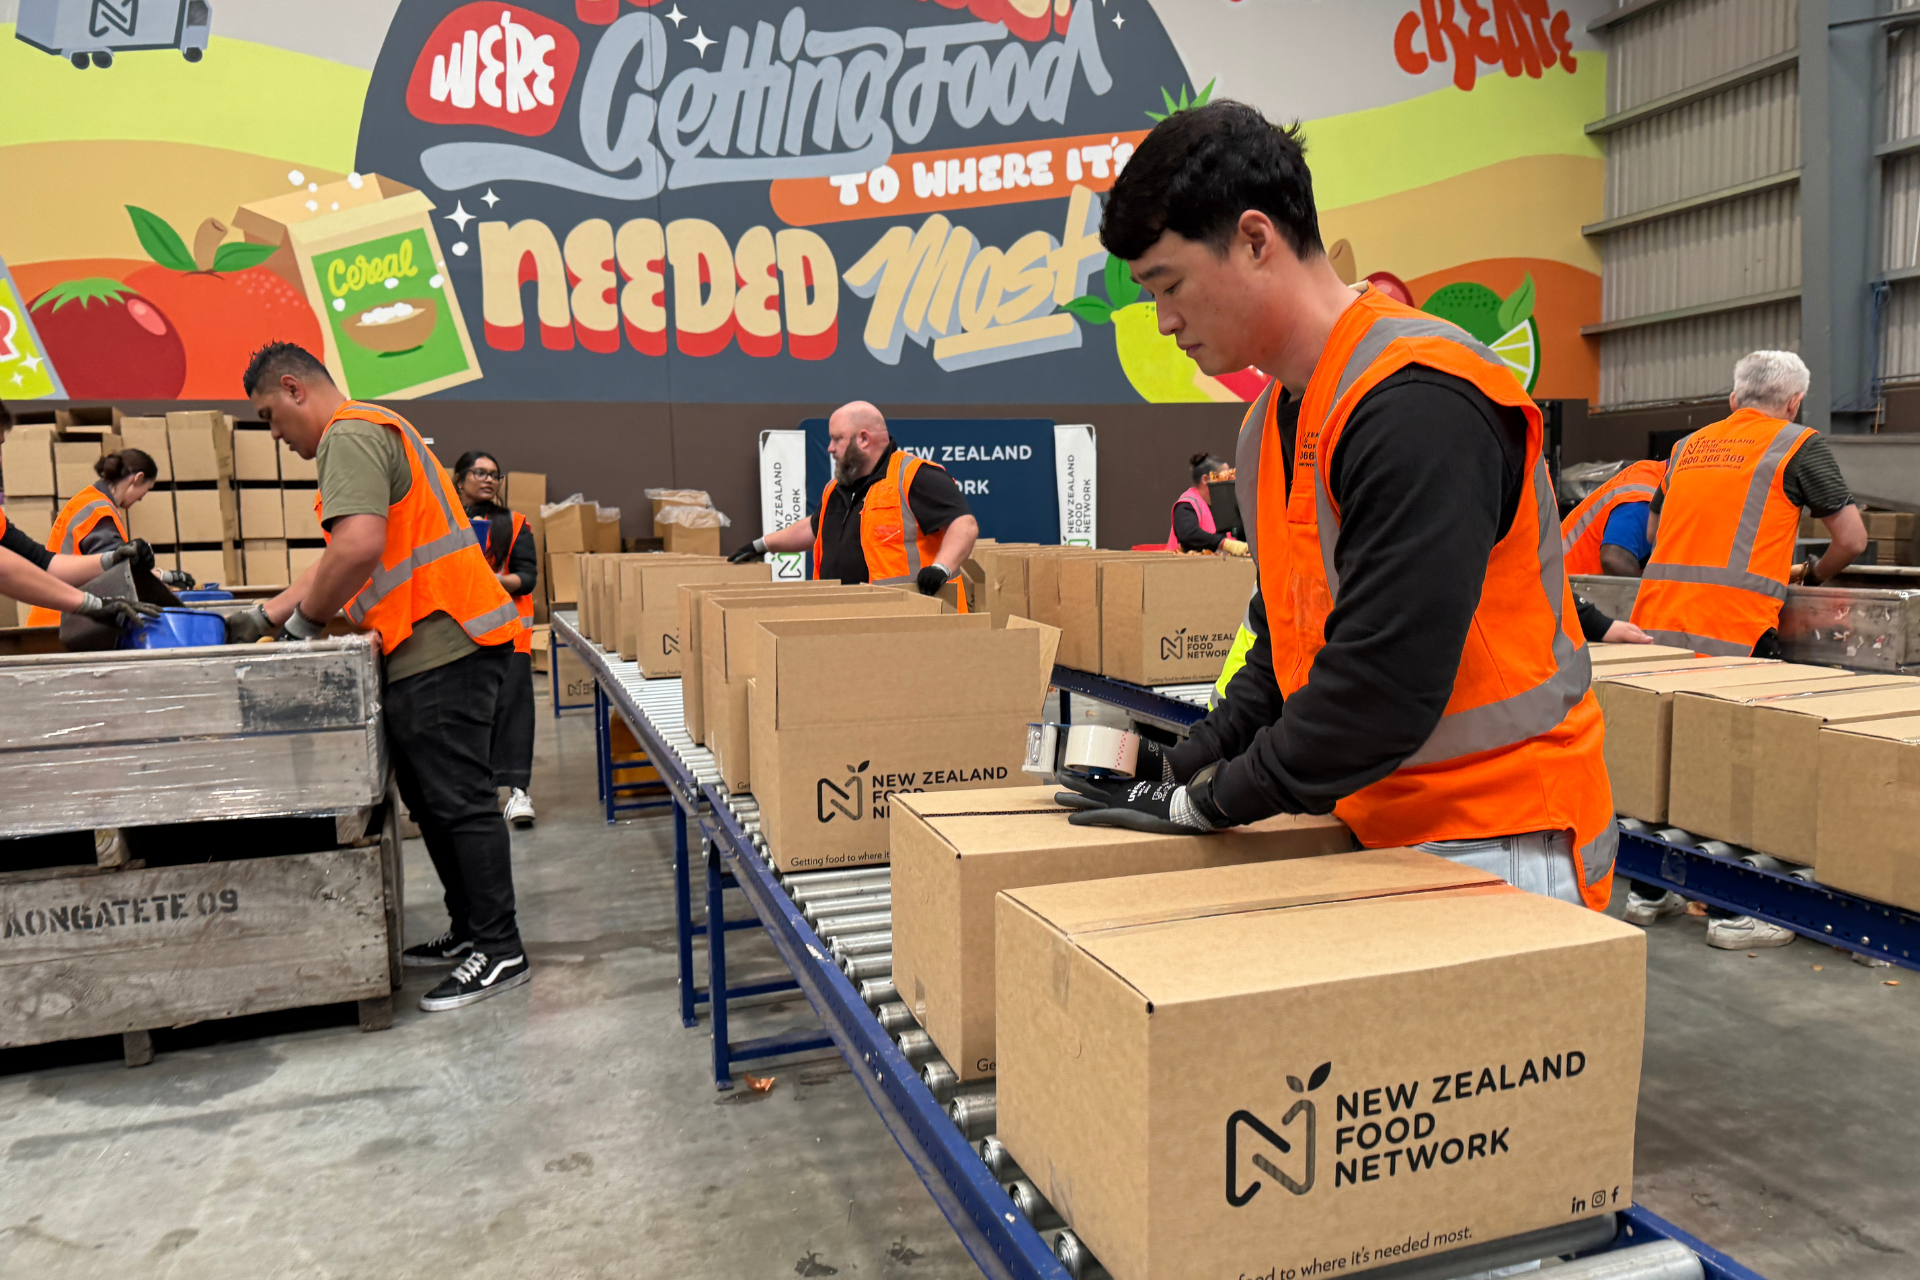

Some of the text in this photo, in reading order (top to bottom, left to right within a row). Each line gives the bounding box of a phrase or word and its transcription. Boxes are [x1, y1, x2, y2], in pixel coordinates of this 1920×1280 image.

[578, 0, 1113, 200] Getting Food
[829, 165, 900, 206] TO
[912, 150, 1054, 198] WHERE
[327, 238, 419, 297] Cereal
[478, 183, 1107, 370] NEEDED Most
[941, 445, 1033, 461] ZEALAND
[1700, 454, 1720, 463] 366
[1722, 454, 1745, 464] 369
[773, 462, 784, 516] ZEALAND
[1067, 454, 1075, 533] NEW ZEALAND
[1083, 479, 1091, 533] NETWORK
[1075, 502, 1083, 533] FOOD
[1187, 633, 1236, 642] NEW ZEAL
[1187, 643, 1213, 651] FOOD
[872, 766, 1008, 788] NEW ZEALAND
[790, 857, 824, 867] Getting
[825, 853, 845, 864] food
[847, 854, 856, 862] to
[858, 851, 882, 861] where
[3, 888, 239, 939] AONGATETE 09
[1336, 1050, 1586, 1122] NEW ZEALAND
[1334, 1127, 1510, 1188] NETWORK
[1335, 1112, 1436, 1155] FOOD
[1301, 1257, 1347, 1278] where
[1351, 1246, 1370, 1266] it's
[1374, 1232, 1430, 1260] needed
[1433, 1226, 1473, 1248] most.
